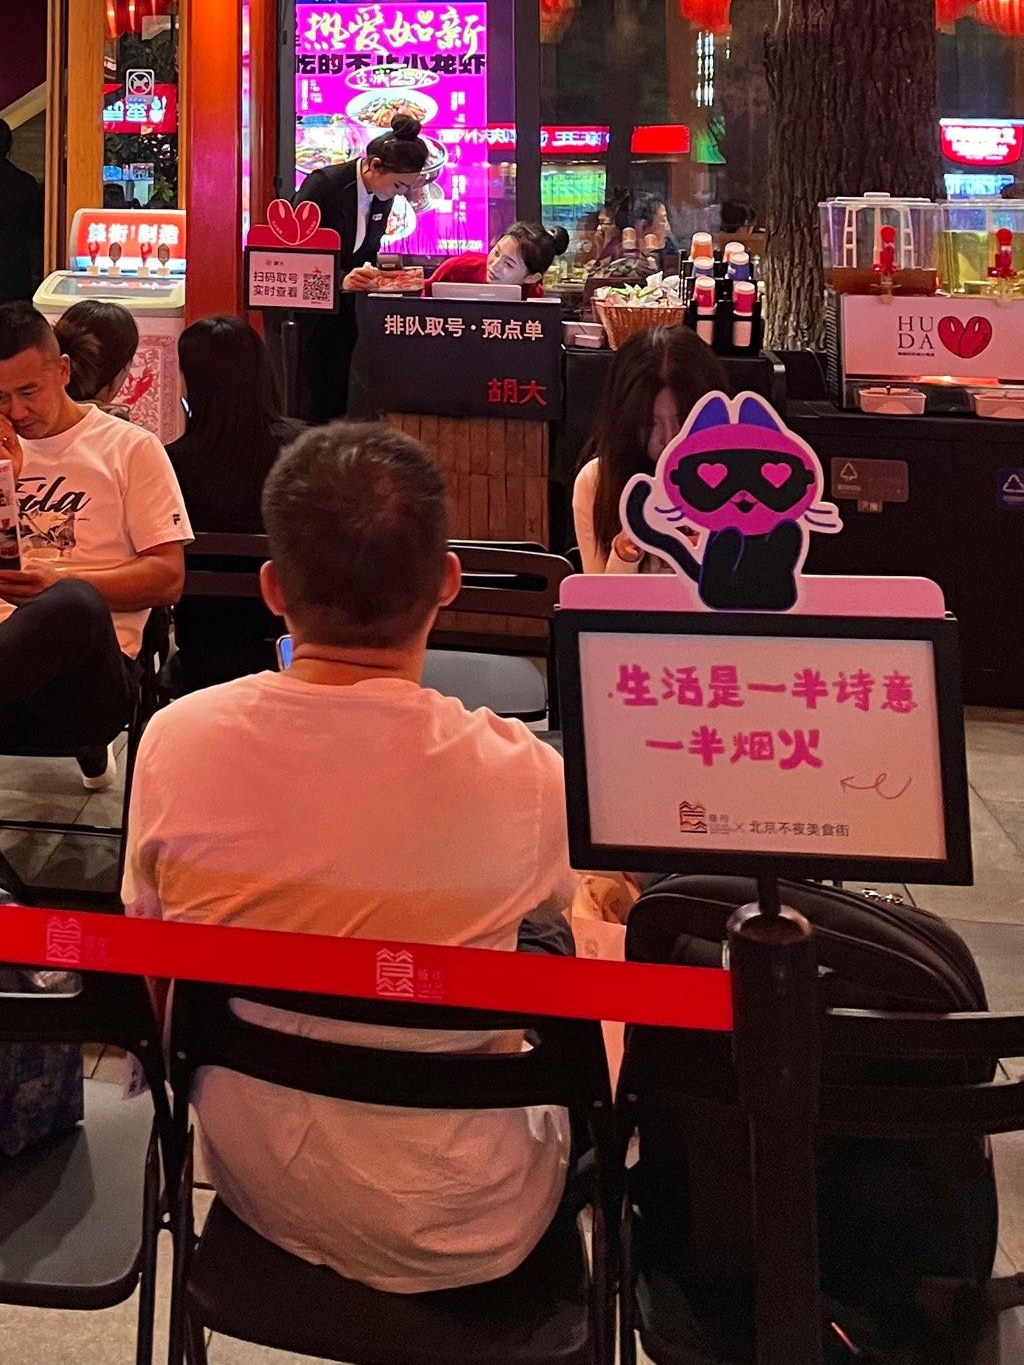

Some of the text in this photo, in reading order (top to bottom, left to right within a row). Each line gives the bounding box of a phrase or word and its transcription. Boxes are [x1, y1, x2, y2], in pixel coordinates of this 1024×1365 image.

[254, 271, 298, 284] 扫码取号
[254, 285, 298, 297] 实时查看
[898, 316, 933, 332] HU
[898, 333, 934, 349] DA
[488, 378, 547, 407] 胡大
[616, 664, 918, 714] 生活是一半诗意
[645, 725, 824, 771] 一半烟火
